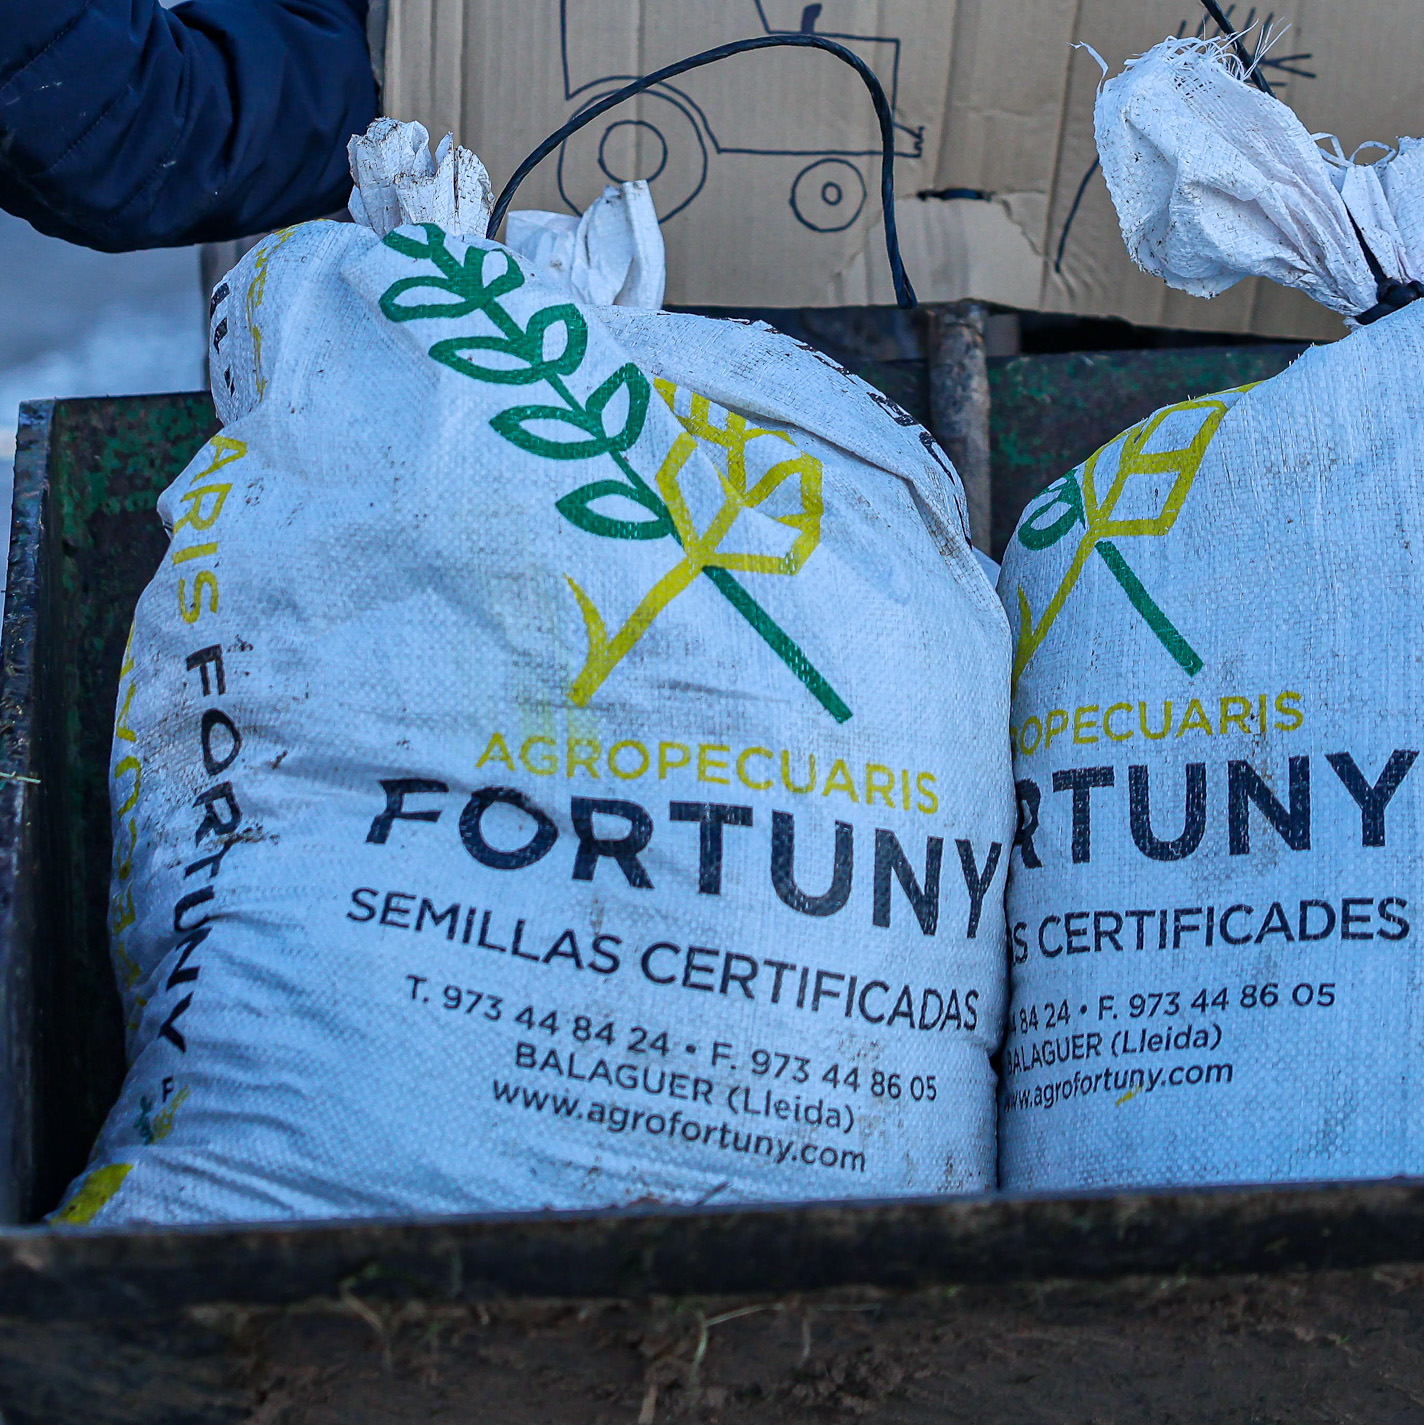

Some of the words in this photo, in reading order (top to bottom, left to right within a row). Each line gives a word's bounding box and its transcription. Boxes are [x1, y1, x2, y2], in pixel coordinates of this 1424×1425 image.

[1011, 689, 1305, 756] OPECUARIS
[477, 731, 940, 816] AGROPECUARIS
[365, 778, 1003, 940] FORTUNY
[345, 885, 624, 975] SEMILLAS
[639, 940, 980, 1033] CERTIFICADAS
[1037, 896, 1412, 960] CERTIFICADES
[405, 973, 431, 1004] T.
[442, 984, 504, 1022] 973
[513, 1004, 561, 1037] 44
[570, 1014, 617, 1047] 84
[626, 1026, 671, 1058] 24
[710, 1040, 738, 1072] F.
[750, 1048, 812, 1085] 973
[820, 1063, 862, 1094] 44
[869, 1070, 904, 1102] 86
[908, 1074, 939, 1103] 05
[1019, 1003, 1039, 1036] 84
[1043, 998, 1072, 1031] 24
[1097, 994, 1119, 1022] F.
[1128, 990, 1182, 1020] 973
[1190, 987, 1231, 1015] 44
[1239, 982, 1279, 1010] 86
[1291, 981, 1337, 1008] 05
[1110, 1022, 1224, 1060] (Lleida)
[492, 1078, 867, 1174] www.agrofortuny.com
[514, 1040, 714, 1106] BALAGUER
[727, 1084, 856, 1136] (Lleida)
